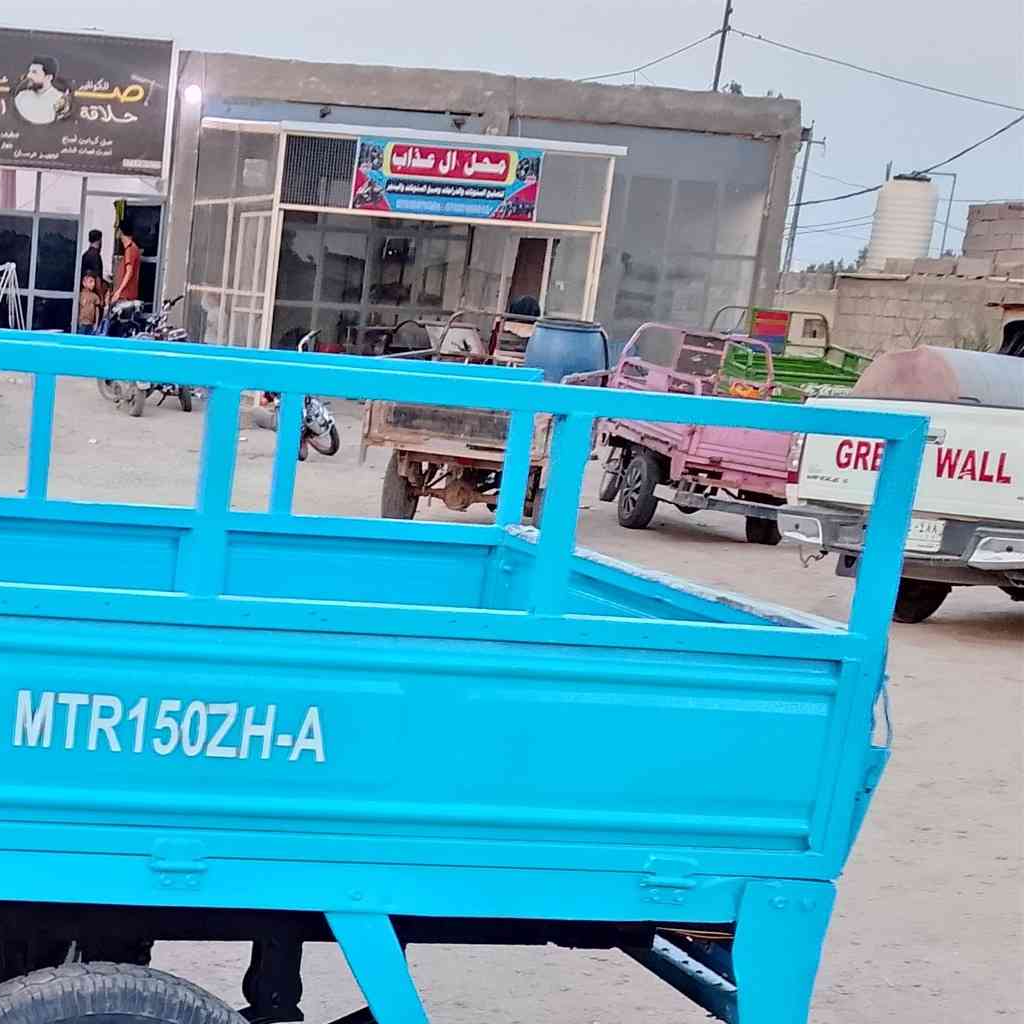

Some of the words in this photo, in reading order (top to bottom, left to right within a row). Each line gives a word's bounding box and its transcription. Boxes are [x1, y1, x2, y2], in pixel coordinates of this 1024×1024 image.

[80, 104, 138, 123] حلاقة
[464, 152, 506, 176] محل
[835, 438, 886, 472] GRE
[936, 447, 1012, 484] WALL
[12, 689, 326, 762] MTR150ZH-A
